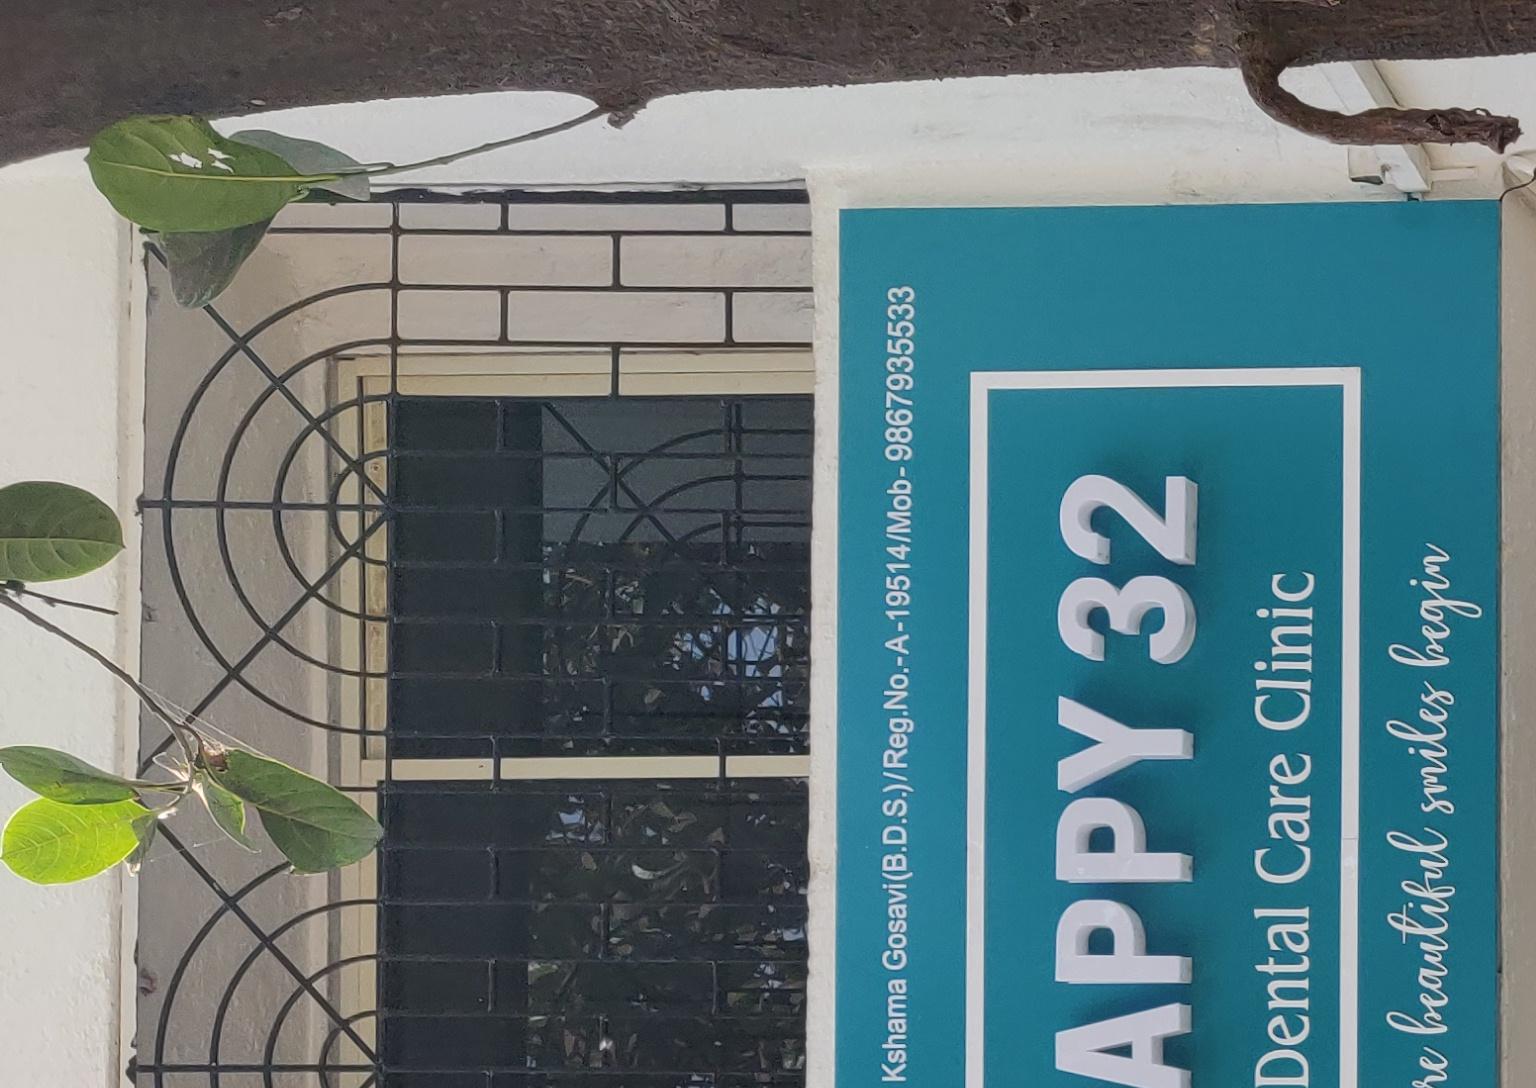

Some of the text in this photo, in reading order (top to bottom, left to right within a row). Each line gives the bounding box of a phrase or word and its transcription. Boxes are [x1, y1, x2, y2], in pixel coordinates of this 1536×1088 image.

[1058, 475, 1197, 664] 32
[1388, 543, 1482, 667] begin
[1386, 681, 1455, 815] smiles
[1253, 572, 1315, 1088] Dental Care Clinic
[1386, 827, 1456, 1035] beautiful
[881, 979, 907, 1082] Kshama
